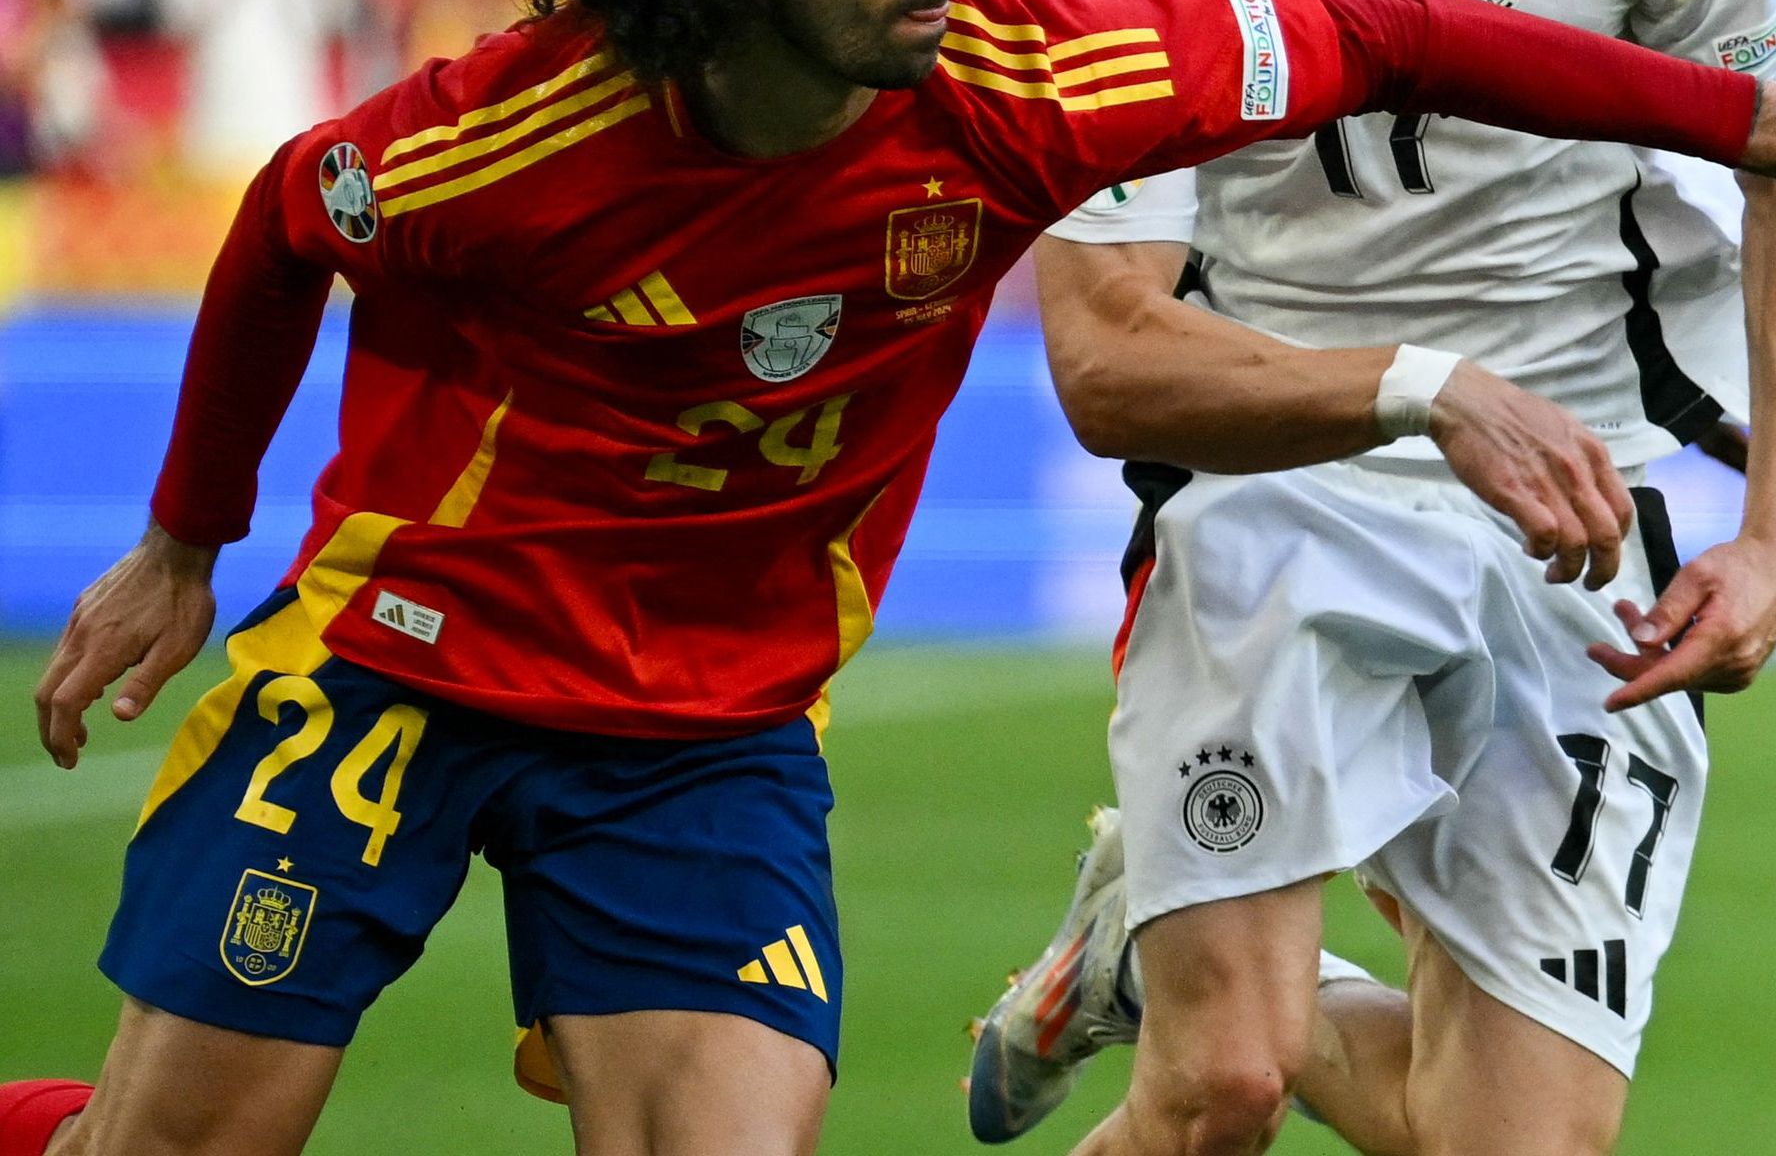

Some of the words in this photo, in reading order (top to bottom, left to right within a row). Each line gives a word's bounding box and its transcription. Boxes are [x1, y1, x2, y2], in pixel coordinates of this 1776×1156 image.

[1717, 36, 1750, 53] UEFA
[1243, 83, 1256, 116] UEFA
[644, 390, 858, 492] 24
[234, 675, 429, 868] 24
[1550, 733, 1680, 921] 17
